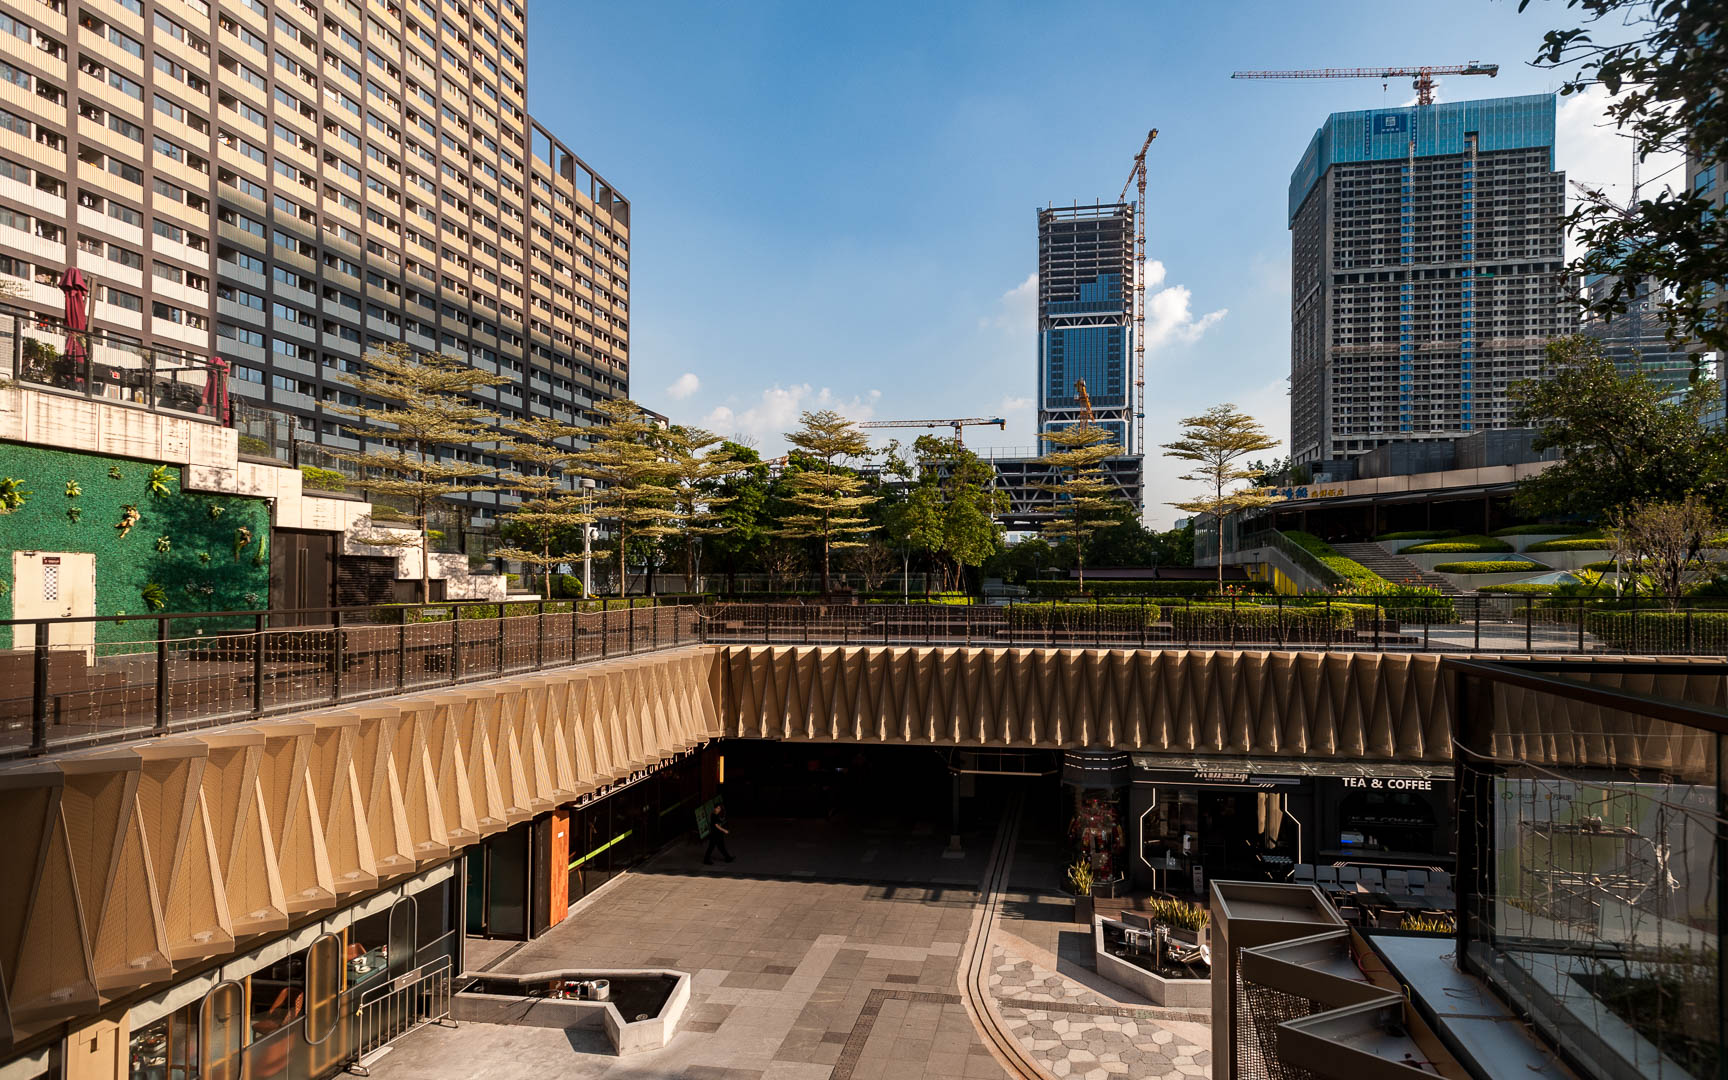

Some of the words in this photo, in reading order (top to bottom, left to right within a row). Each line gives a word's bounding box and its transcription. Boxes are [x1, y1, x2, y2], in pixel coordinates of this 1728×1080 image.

[1342, 777, 1367, 788] TEA
[1370, 778, 1384, 789] &
[1387, 779, 1432, 791] COFFEE
